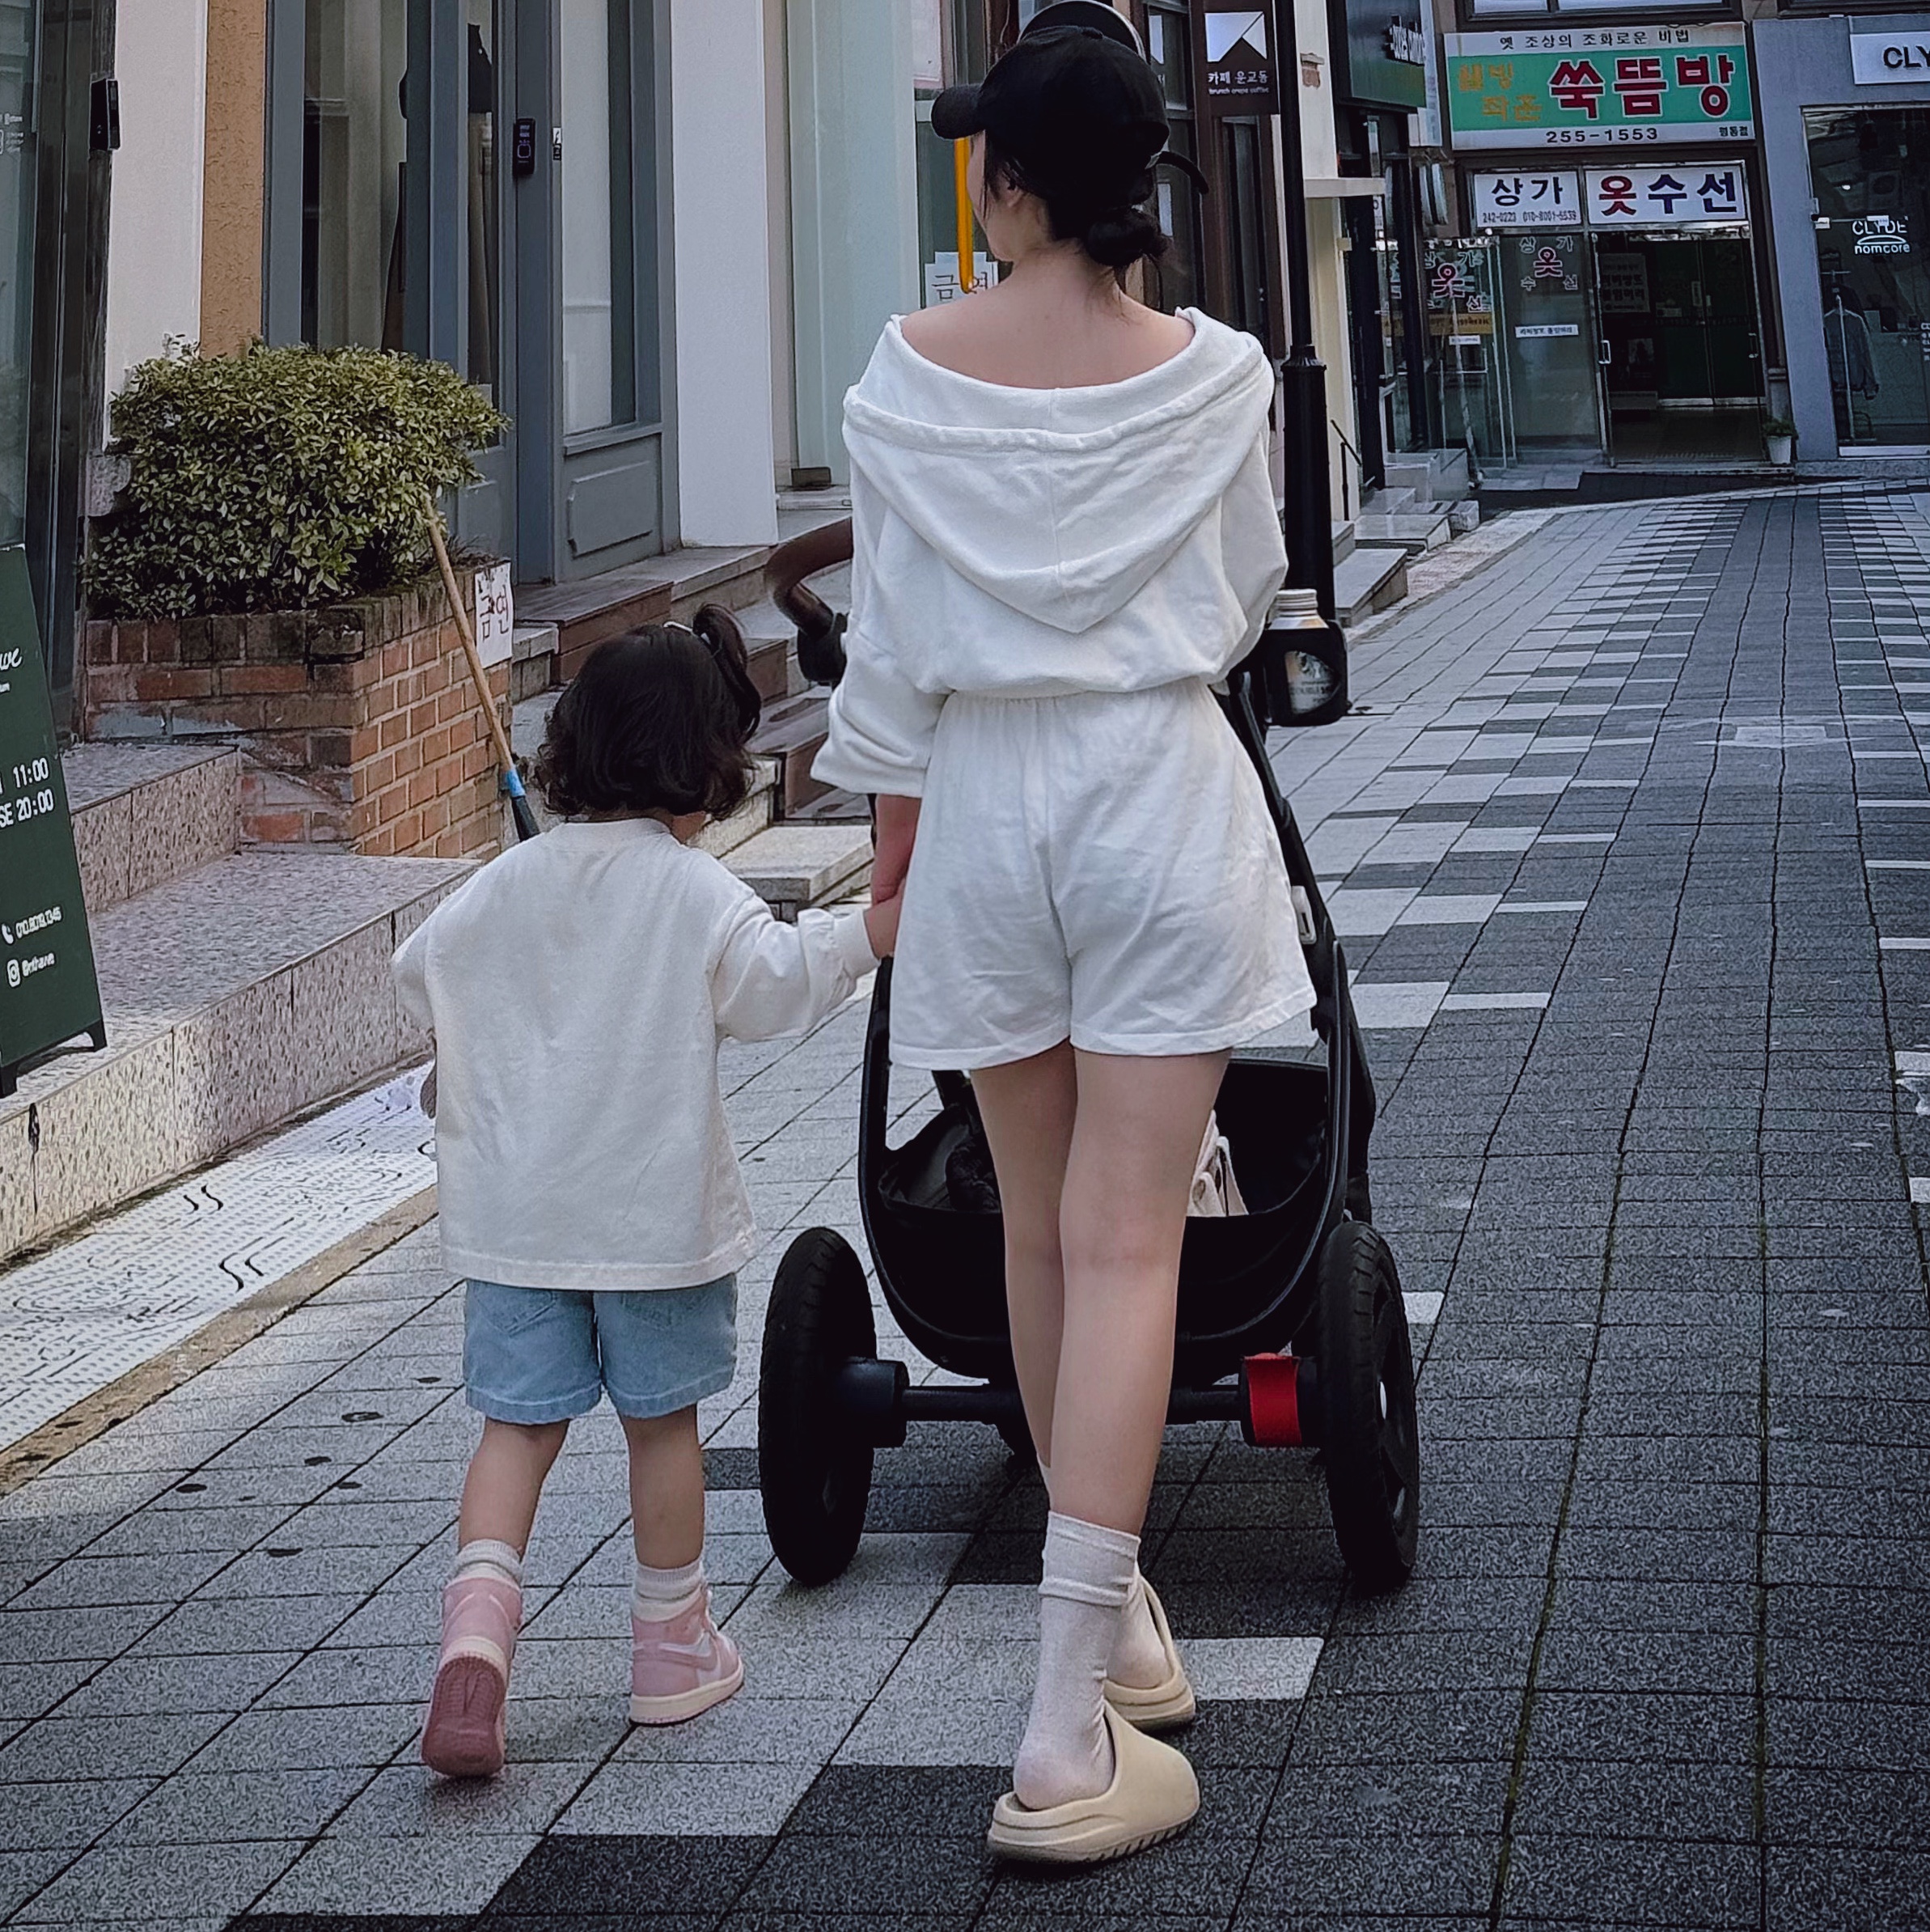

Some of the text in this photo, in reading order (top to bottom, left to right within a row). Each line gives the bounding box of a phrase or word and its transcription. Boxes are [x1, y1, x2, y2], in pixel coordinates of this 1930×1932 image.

[1500, 29, 1690, 50] 옛 조상의 조화로운 비법
[1207, 70, 1268, 85] 카페 운교동
[1547, 53, 1735, 120] 쑥뜸방
[1545, 128, 1659, 144] 255-1553
[1492, 176, 1564, 207] 상가
[1854, 244, 1911, 256] nomcore
[12, 757, 49, 789] 11:00
[16, 788, 54, 822] 20:00
